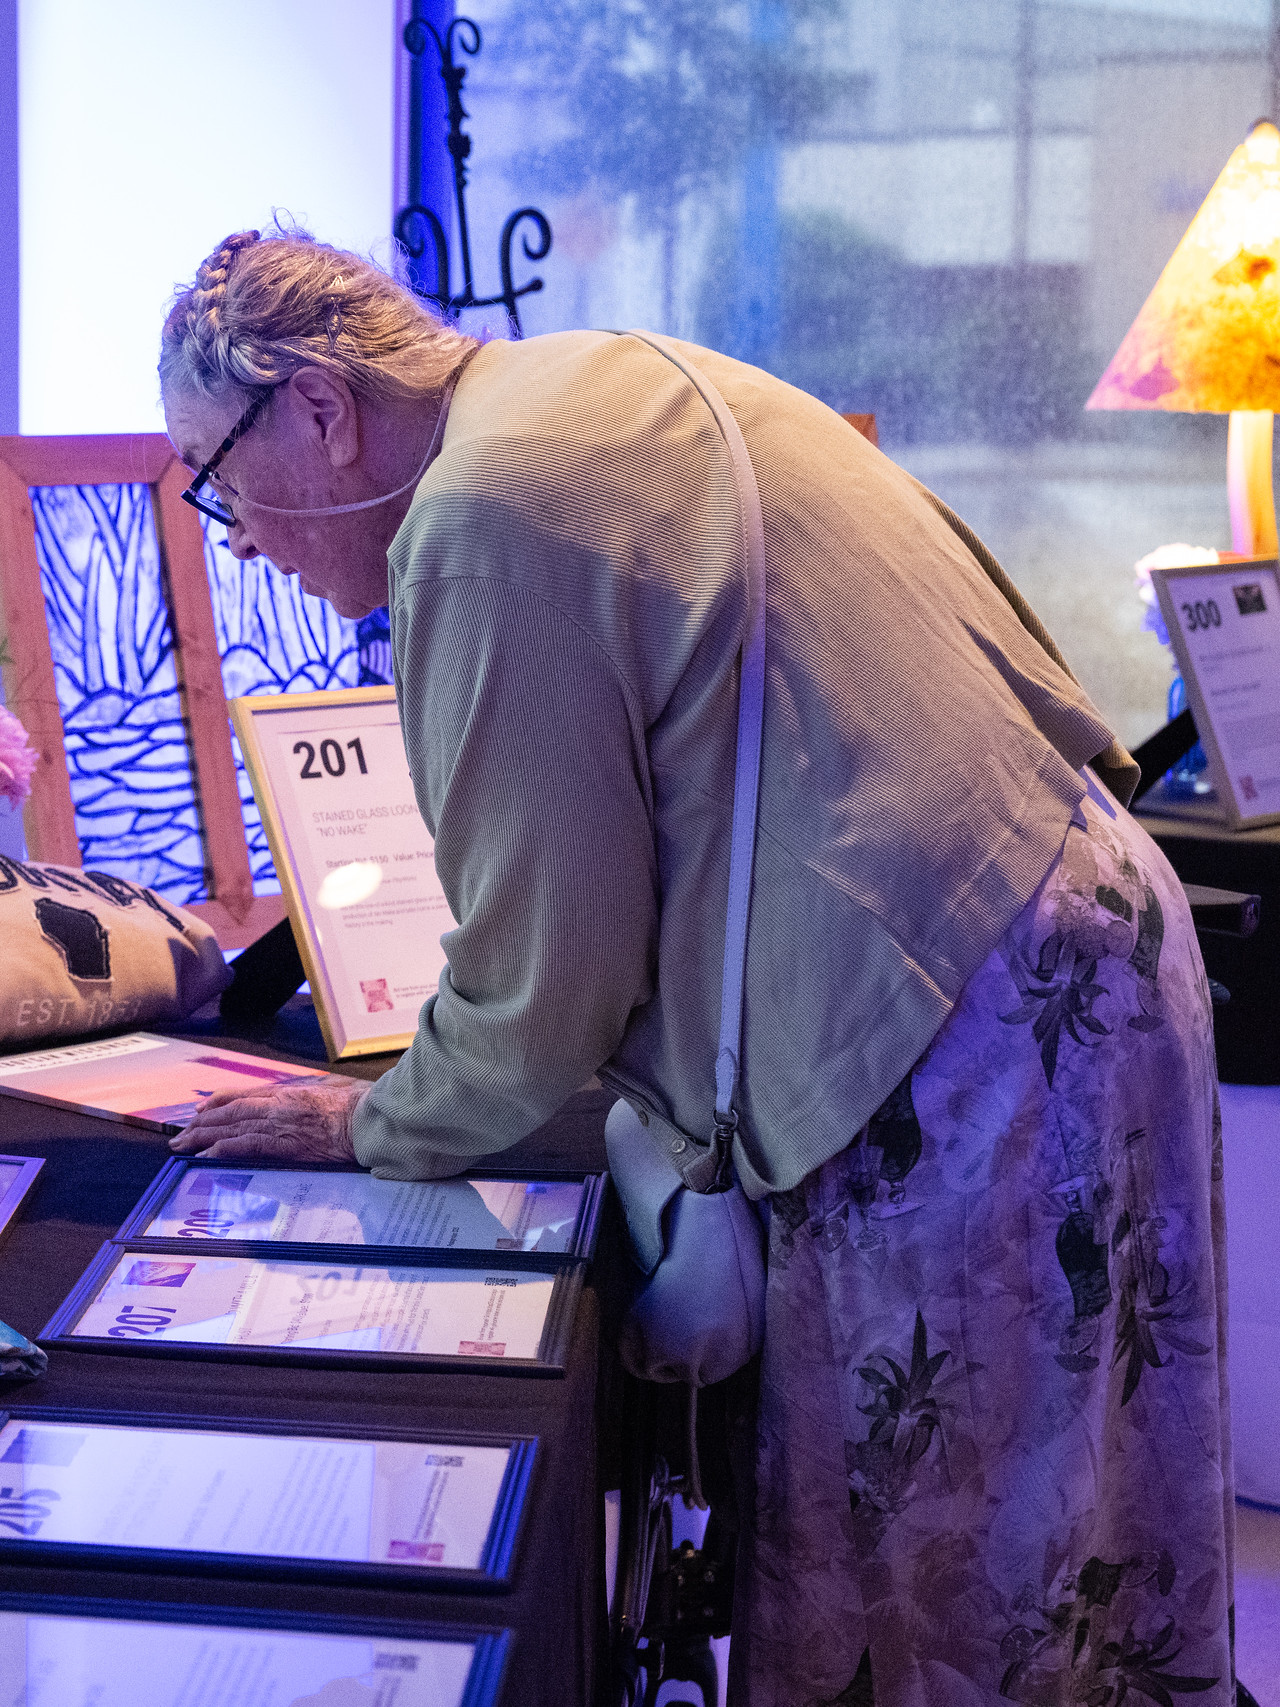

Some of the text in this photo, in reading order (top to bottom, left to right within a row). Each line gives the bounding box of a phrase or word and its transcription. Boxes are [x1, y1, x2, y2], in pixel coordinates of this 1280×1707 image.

[1182, 600, 1221, 632] 300
[293, 737, 369, 780] 201
[312, 809, 355, 824] STAINED
[356, 806, 389, 820] GLASS
[16, 998, 71, 1027] EST.
[108, 1305, 177, 1338] 207
